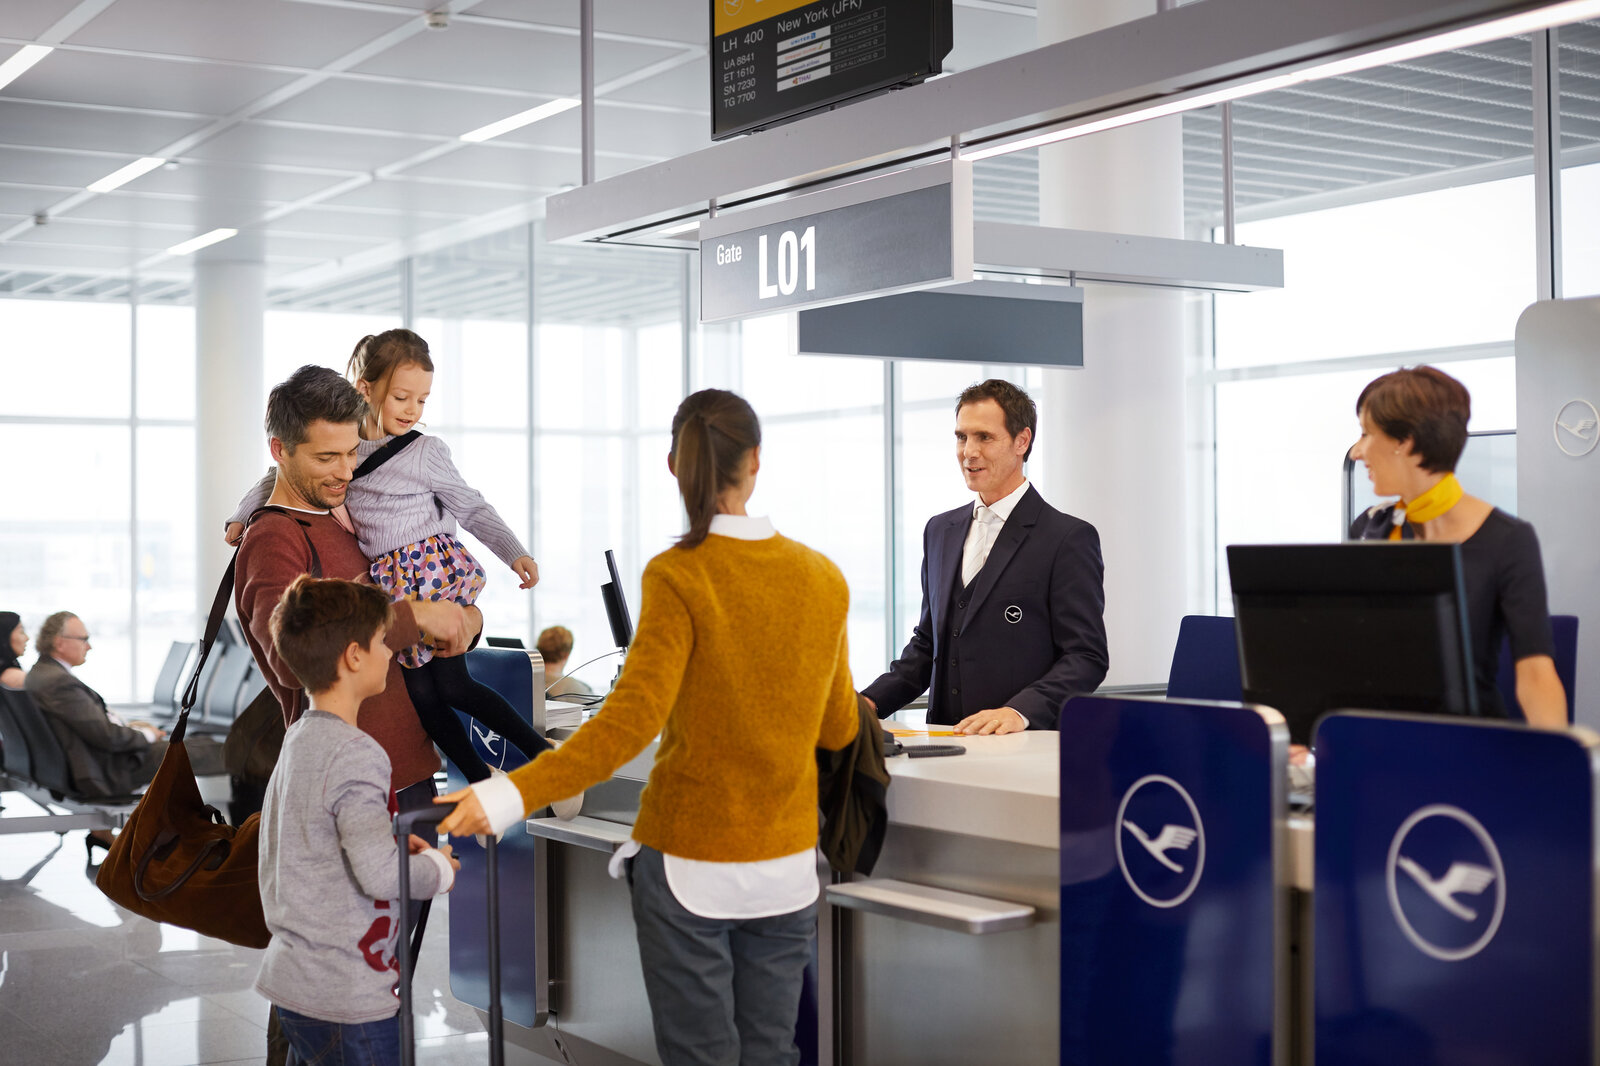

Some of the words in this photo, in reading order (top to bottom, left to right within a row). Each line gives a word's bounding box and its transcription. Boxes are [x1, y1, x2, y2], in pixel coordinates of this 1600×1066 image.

[777, 17, 801, 34] New
[804, 7, 829, 24] York
[831, 0, 862, 18] (JFK)
[722, 37, 738, 53] LH
[744, 28, 764, 45] 400
[723, 58, 736, 70] UA
[736, 52, 755, 67] 8841
[723, 71, 735, 83] ET
[736, 65, 755, 79] 1610
[723, 84, 736, 96] SN
[737, 78, 756, 91] 7230
[723, 97, 736, 108] TG
[737, 90, 756, 104] 7700
[716, 244, 742, 266] Gate
[758, 226, 816, 300] L01
